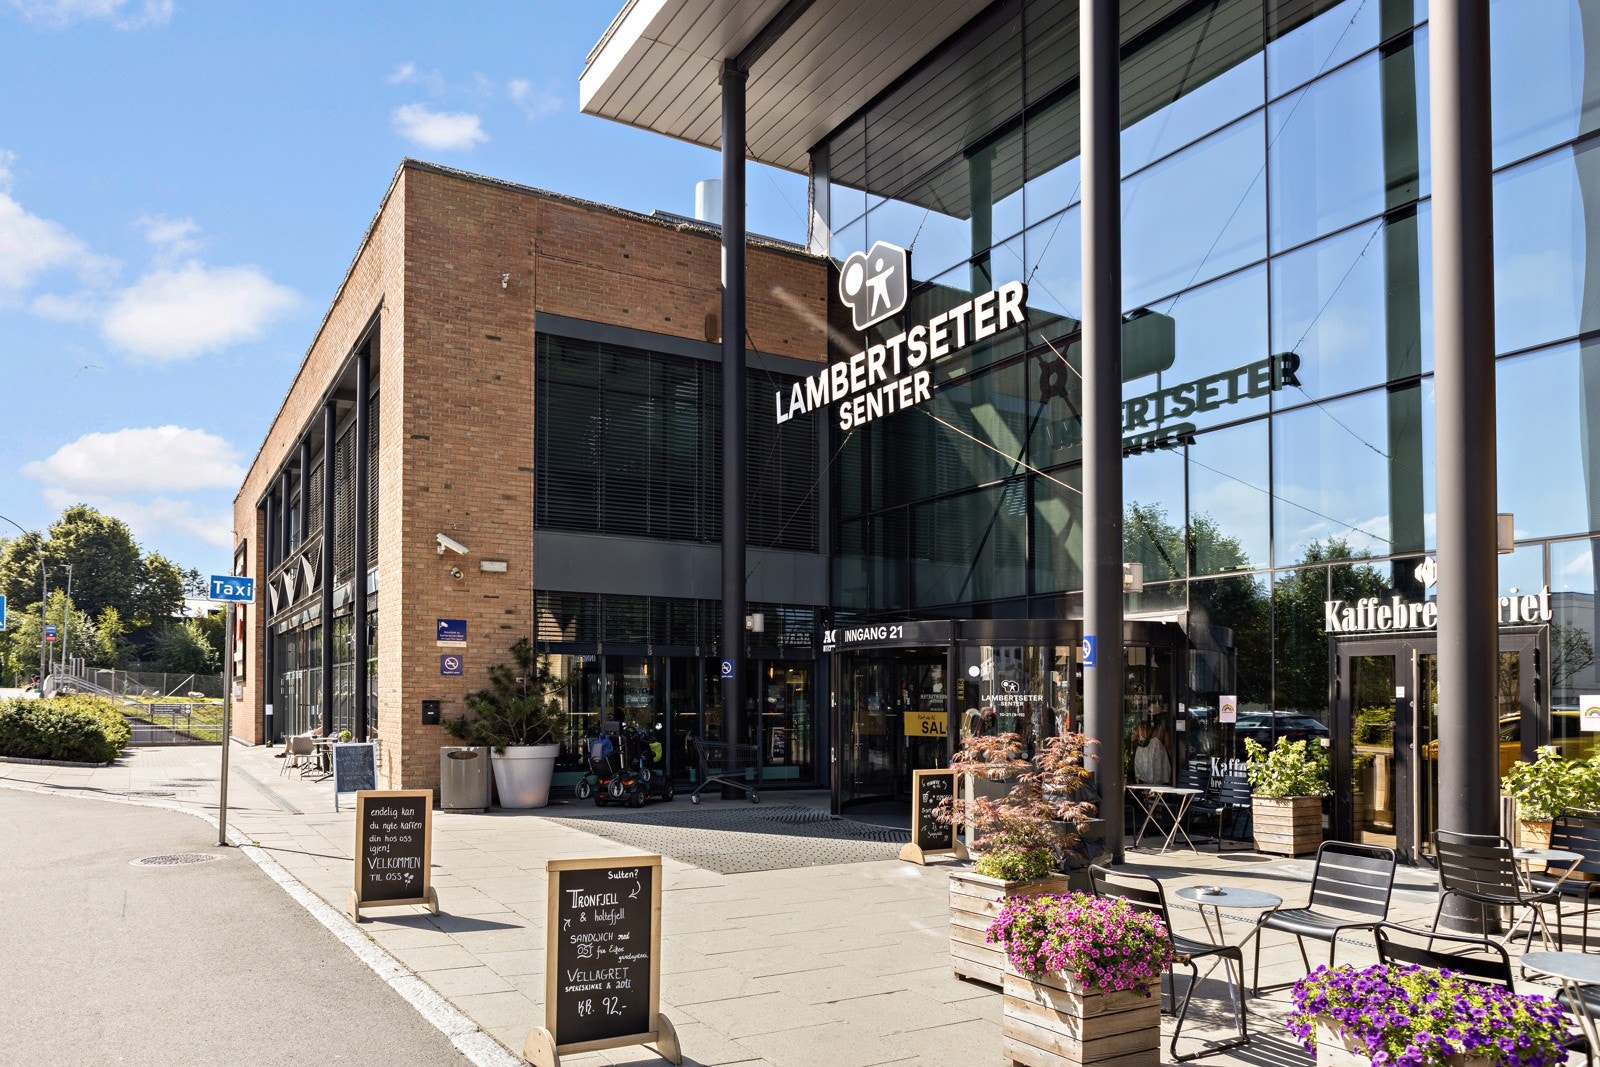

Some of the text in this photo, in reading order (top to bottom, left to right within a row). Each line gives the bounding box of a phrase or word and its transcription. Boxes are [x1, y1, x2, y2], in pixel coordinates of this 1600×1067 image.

[775, 280, 1027, 425] LAMBERTSETER
[839, 370, 932, 431] SENTER
[212, 580, 252, 597] Taxi
[1324, 585, 1553, 632] Kaffebreriet
[844, 626, 903, 643] INNGANG 21
[981, 694, 1043, 702] LAMBERTSETER
[921, 721, 948, 735] SAL
[370, 807, 415, 819] endelig kan
[369, 822, 422, 832] du nyte kaffen
[369, 844, 390, 855] igjen!
[367, 857, 421, 869] VELKOMMEN
[369, 872, 402, 881] TIL OSS
[608, 869, 639, 880] Sulten?
[566, 889, 618, 909] TRONFJELL
[579, 908, 625, 925] & holtefjell
[570, 932, 614, 944] SANDWICH
[577, 945, 594, 955] OST
[567, 967, 629, 982] VELLAGRET
[565, 983, 603, 992] SPEKESKINKE
[578, 996, 627, 1017] KR. 92,-
